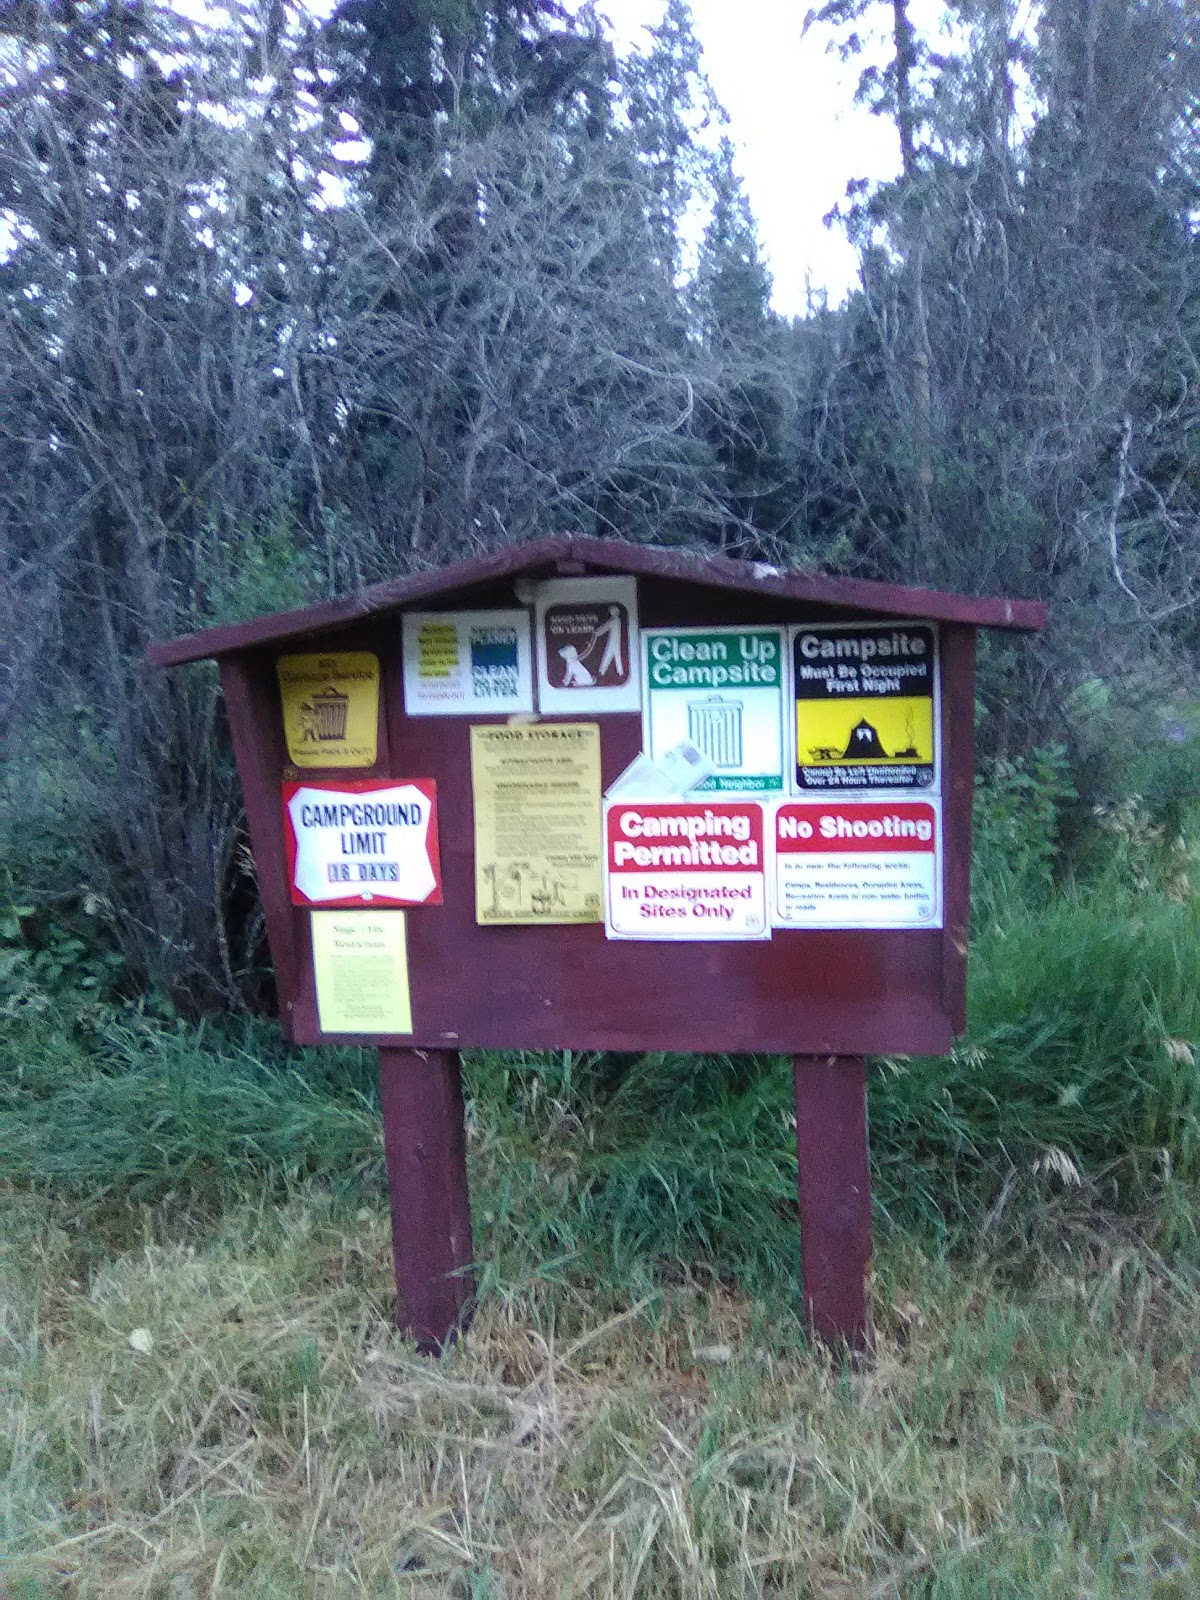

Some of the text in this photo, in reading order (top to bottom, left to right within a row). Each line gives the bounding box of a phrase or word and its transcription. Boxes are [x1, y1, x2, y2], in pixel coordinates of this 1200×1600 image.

[652, 635, 776, 663] Clean Up
[800, 632, 926, 662] Campsite
[472, 665, 519, 677] CLEAN
[652, 659, 777, 688] Campsite
[801, 663, 927, 680] Must Be Occupied
[826, 678, 901, 693] First Night
[802, 765, 917, 777] Cannot Be Left Unattended
[805, 776, 826, 785] Over
[842, 775, 867, 785] Hours
[869, 774, 914, 784] Thereafter
[720, 778, 765, 790] Neighbor
[301, 803, 422, 828] CAMPGROUND
[620, 810, 750, 841] Camping
[778, 815, 932, 841] No Shooting
[340, 832, 387, 855] LIMIT
[613, 840, 758, 866] Permitted
[358, 863, 398, 881] DAYS
[844, 863, 882, 871] following
[622, 884, 752, 903] In Designated
[640, 903, 687, 918] Sites
[692, 903, 735, 921] Only
